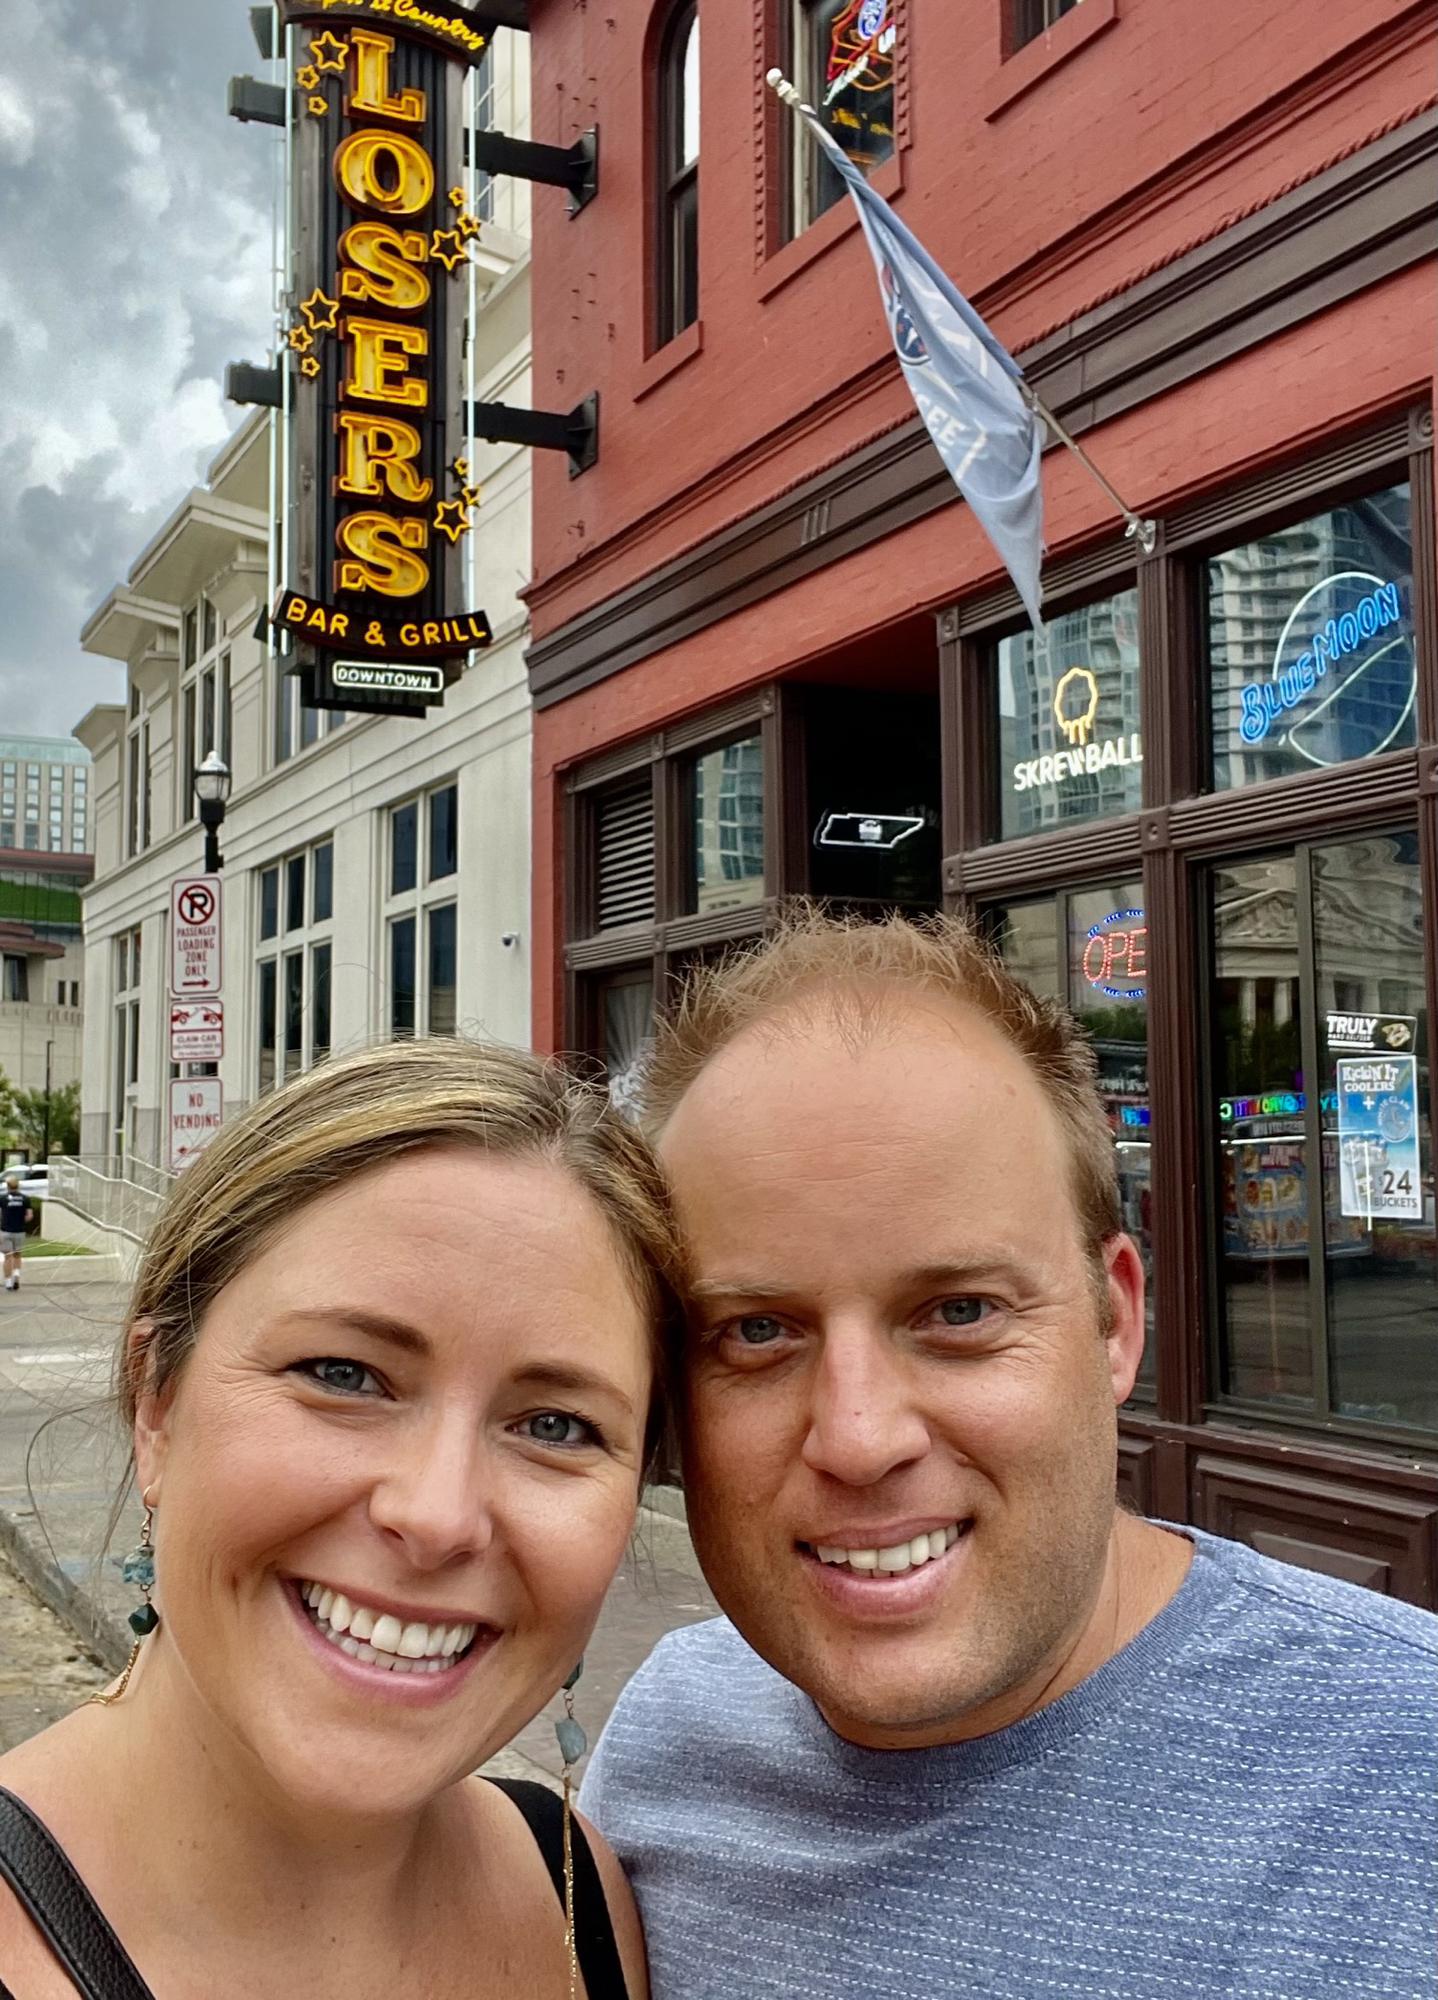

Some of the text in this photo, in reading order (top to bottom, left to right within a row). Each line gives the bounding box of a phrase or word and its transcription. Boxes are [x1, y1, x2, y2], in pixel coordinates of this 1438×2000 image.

[333, 27, 435, 598] LOSERS
[286, 598, 487, 647] BAR & GRILL
[1240, 582, 1400, 744] BLUE MOON
[337, 667, 432, 690] DOWNTOWN
[1013, 733, 1145, 791] SKREWBALL
[176, 926, 216, 938] PASSENGER
[178, 938, 215, 951] LOADING
[186, 950, 207, 963] ZONE
[1083, 928, 1147, 982] OPE
[185, 964, 207, 977] ONLY
[1326, 1015, 1378, 1035] TRULY
[201, 1034, 217, 1042] CAR
[1344, 1081, 1396, 1092] COOLERS
[189, 1092, 204, 1108] NO
[173, 1114, 220, 1130] VENDING
[1374, 1197, 1418, 1209] BUCKETS
